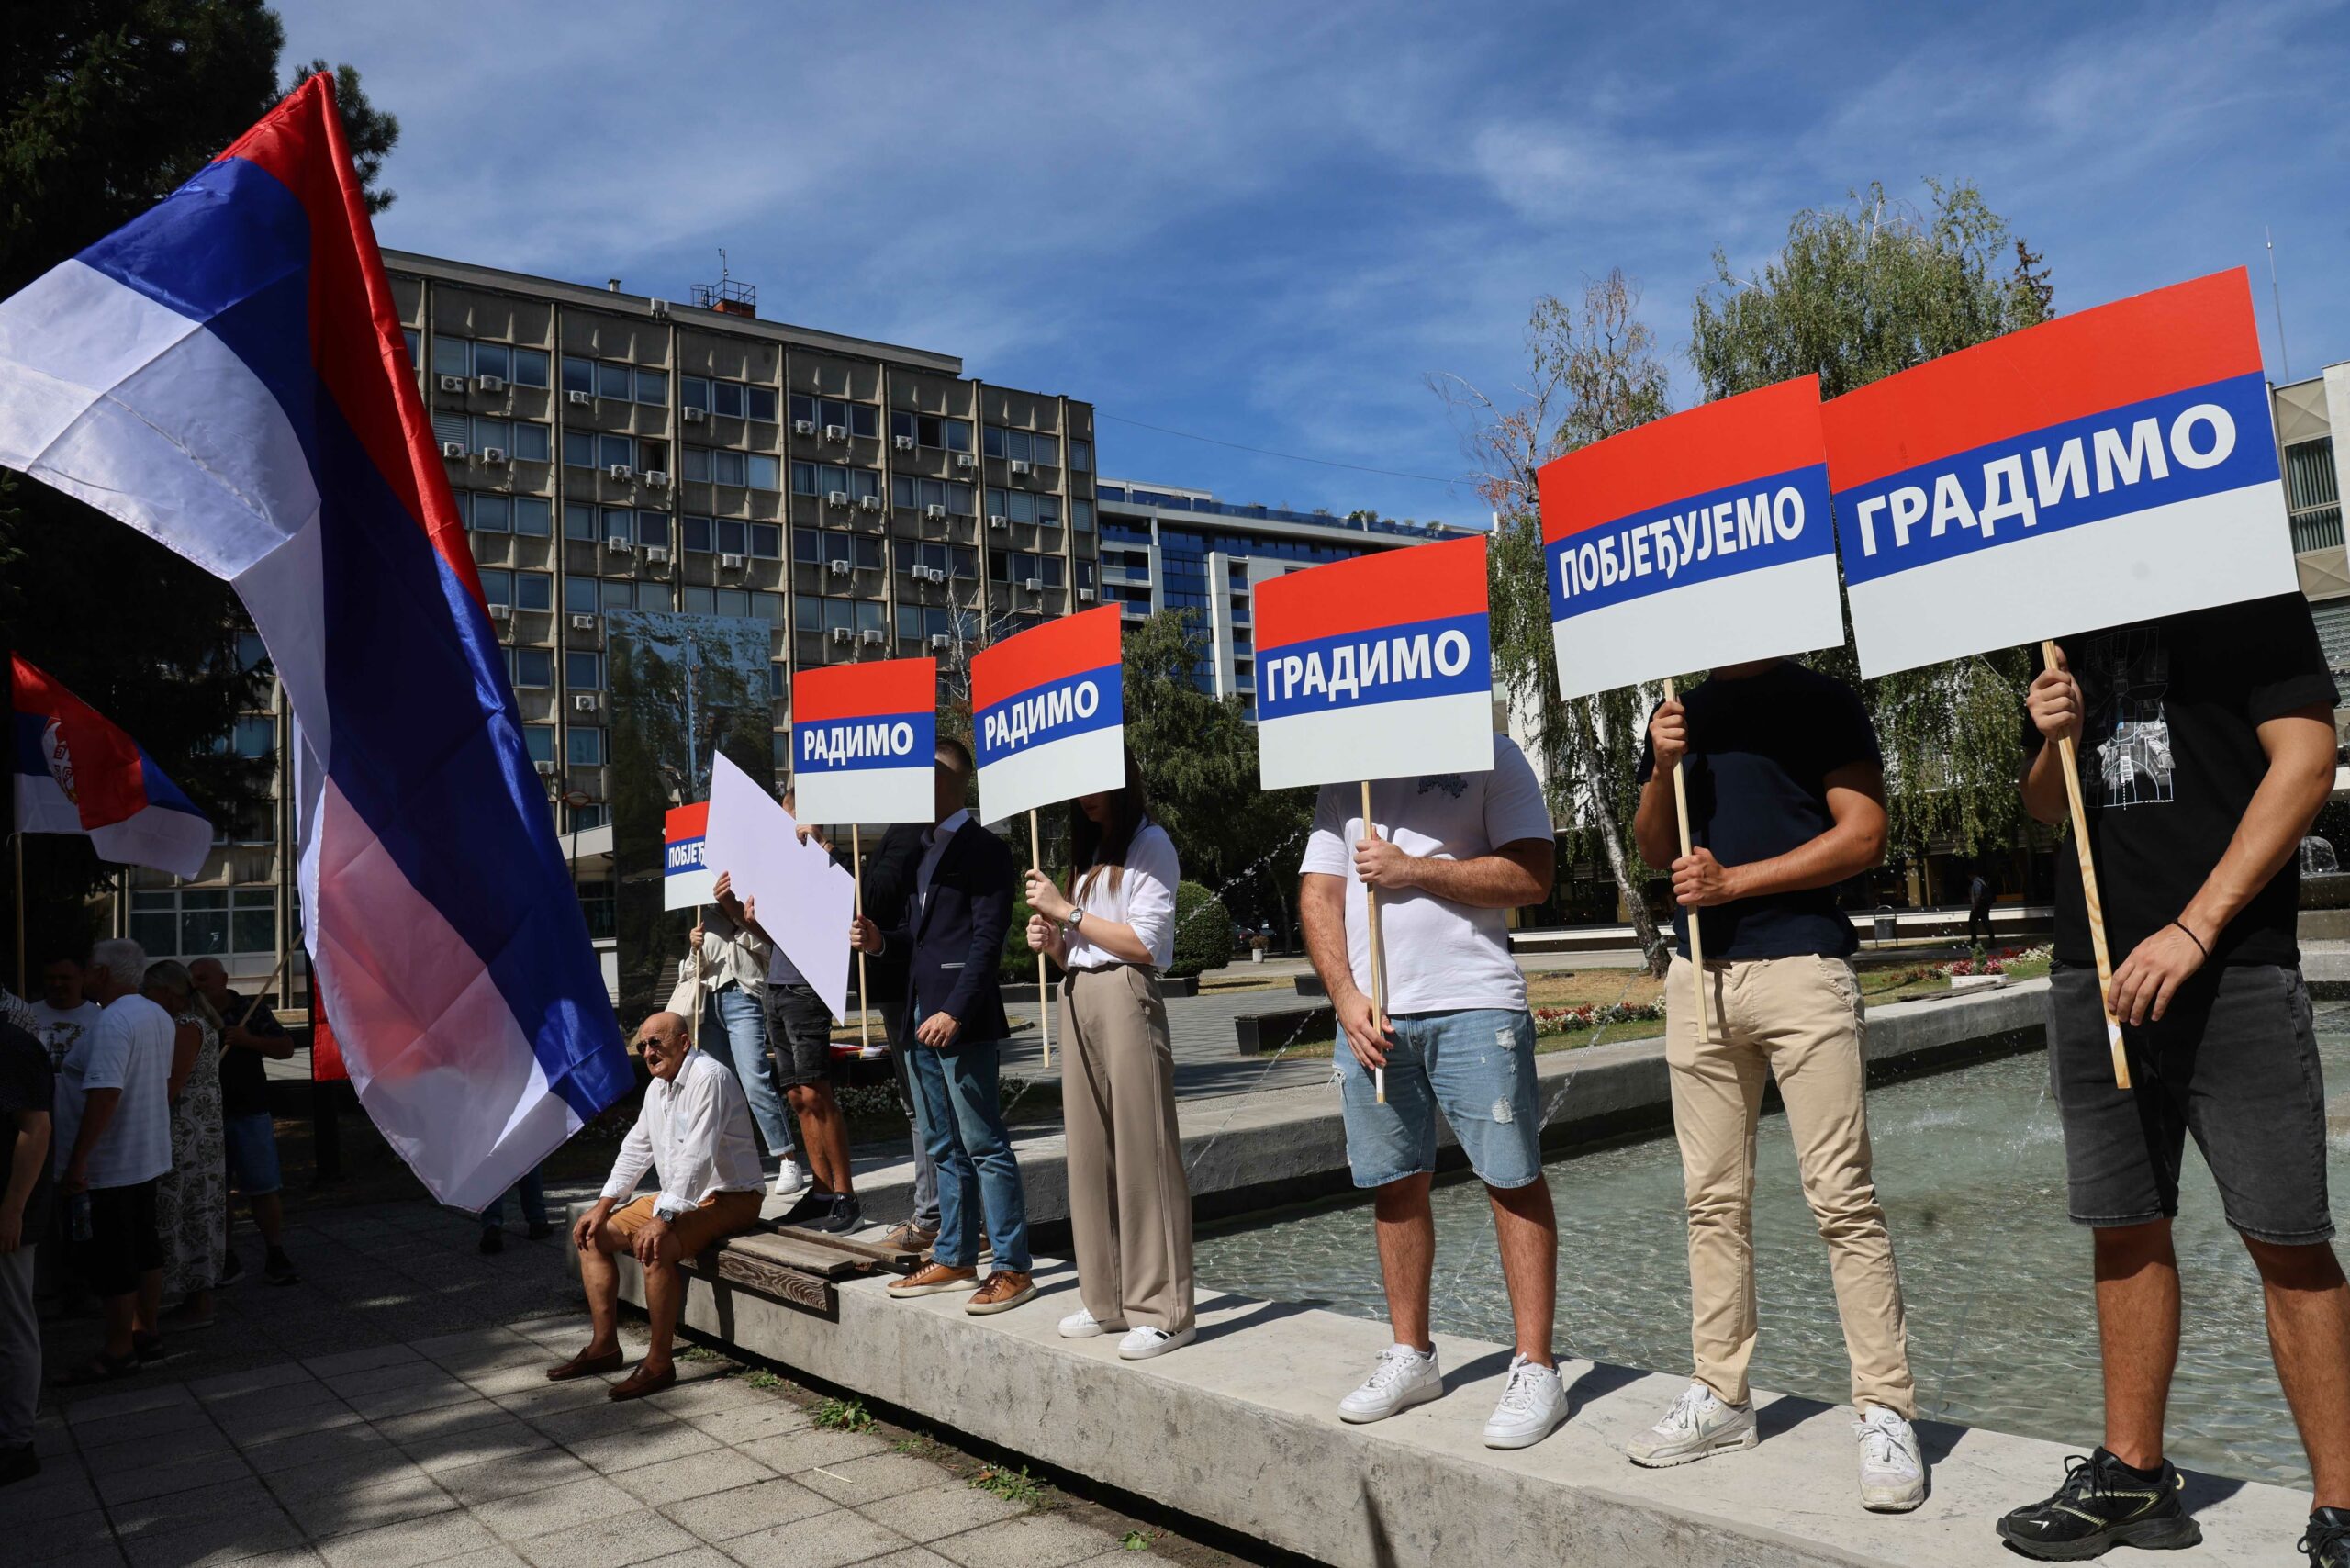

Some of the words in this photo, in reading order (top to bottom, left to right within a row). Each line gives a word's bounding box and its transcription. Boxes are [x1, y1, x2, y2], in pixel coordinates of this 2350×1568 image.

[1856, 404, 2237, 557] ГРАДИМО
[1560, 486, 1806, 599] ПОБЈЕЂУЈЕМО
[1266, 629, 1471, 702] ГРАДИМО
[803, 722, 914, 766] РАДИМО
[984, 680, 1100, 751] РАДИМО
